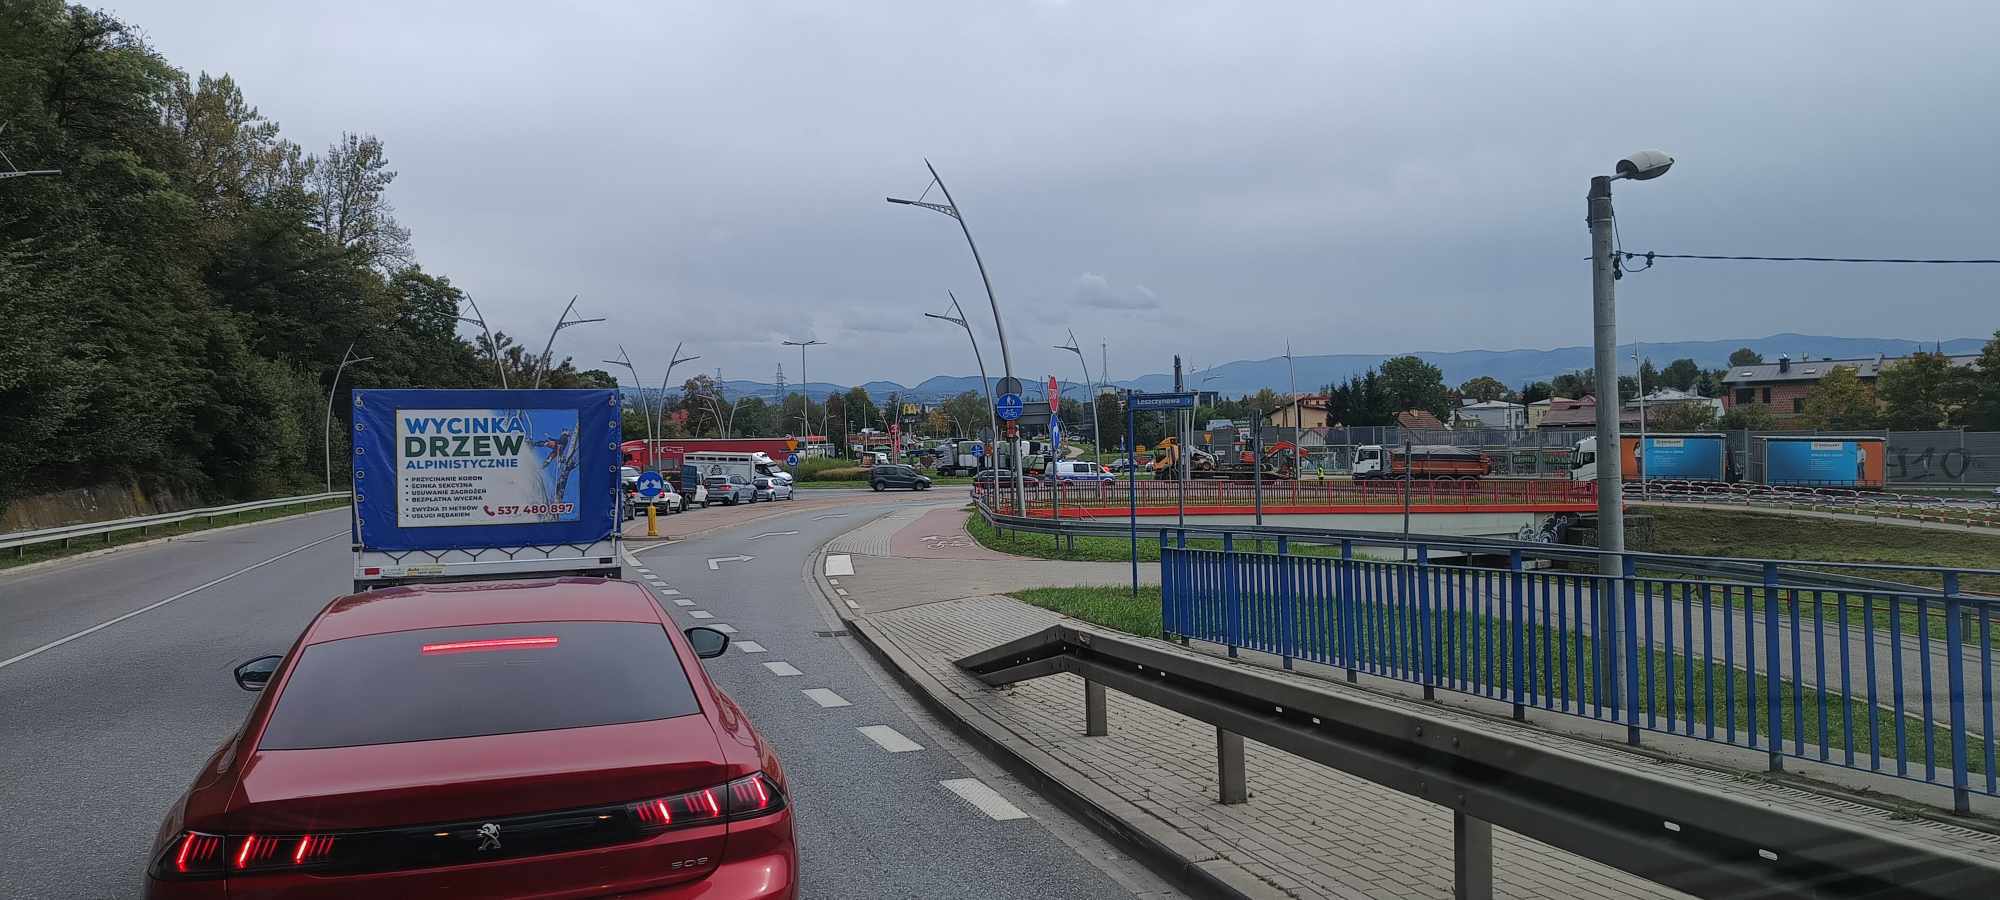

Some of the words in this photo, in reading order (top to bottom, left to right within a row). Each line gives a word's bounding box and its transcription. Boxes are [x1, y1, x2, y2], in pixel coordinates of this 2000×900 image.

[404, 416, 526, 434] WYCINKA
[404, 435, 525, 458] DRZEW
[405, 458, 518, 470] ALPINISTYCZNIE
[497, 505, 519, 515] 537
[523, 504, 547, 514] 480
[550, 503, 573, 513] 897
